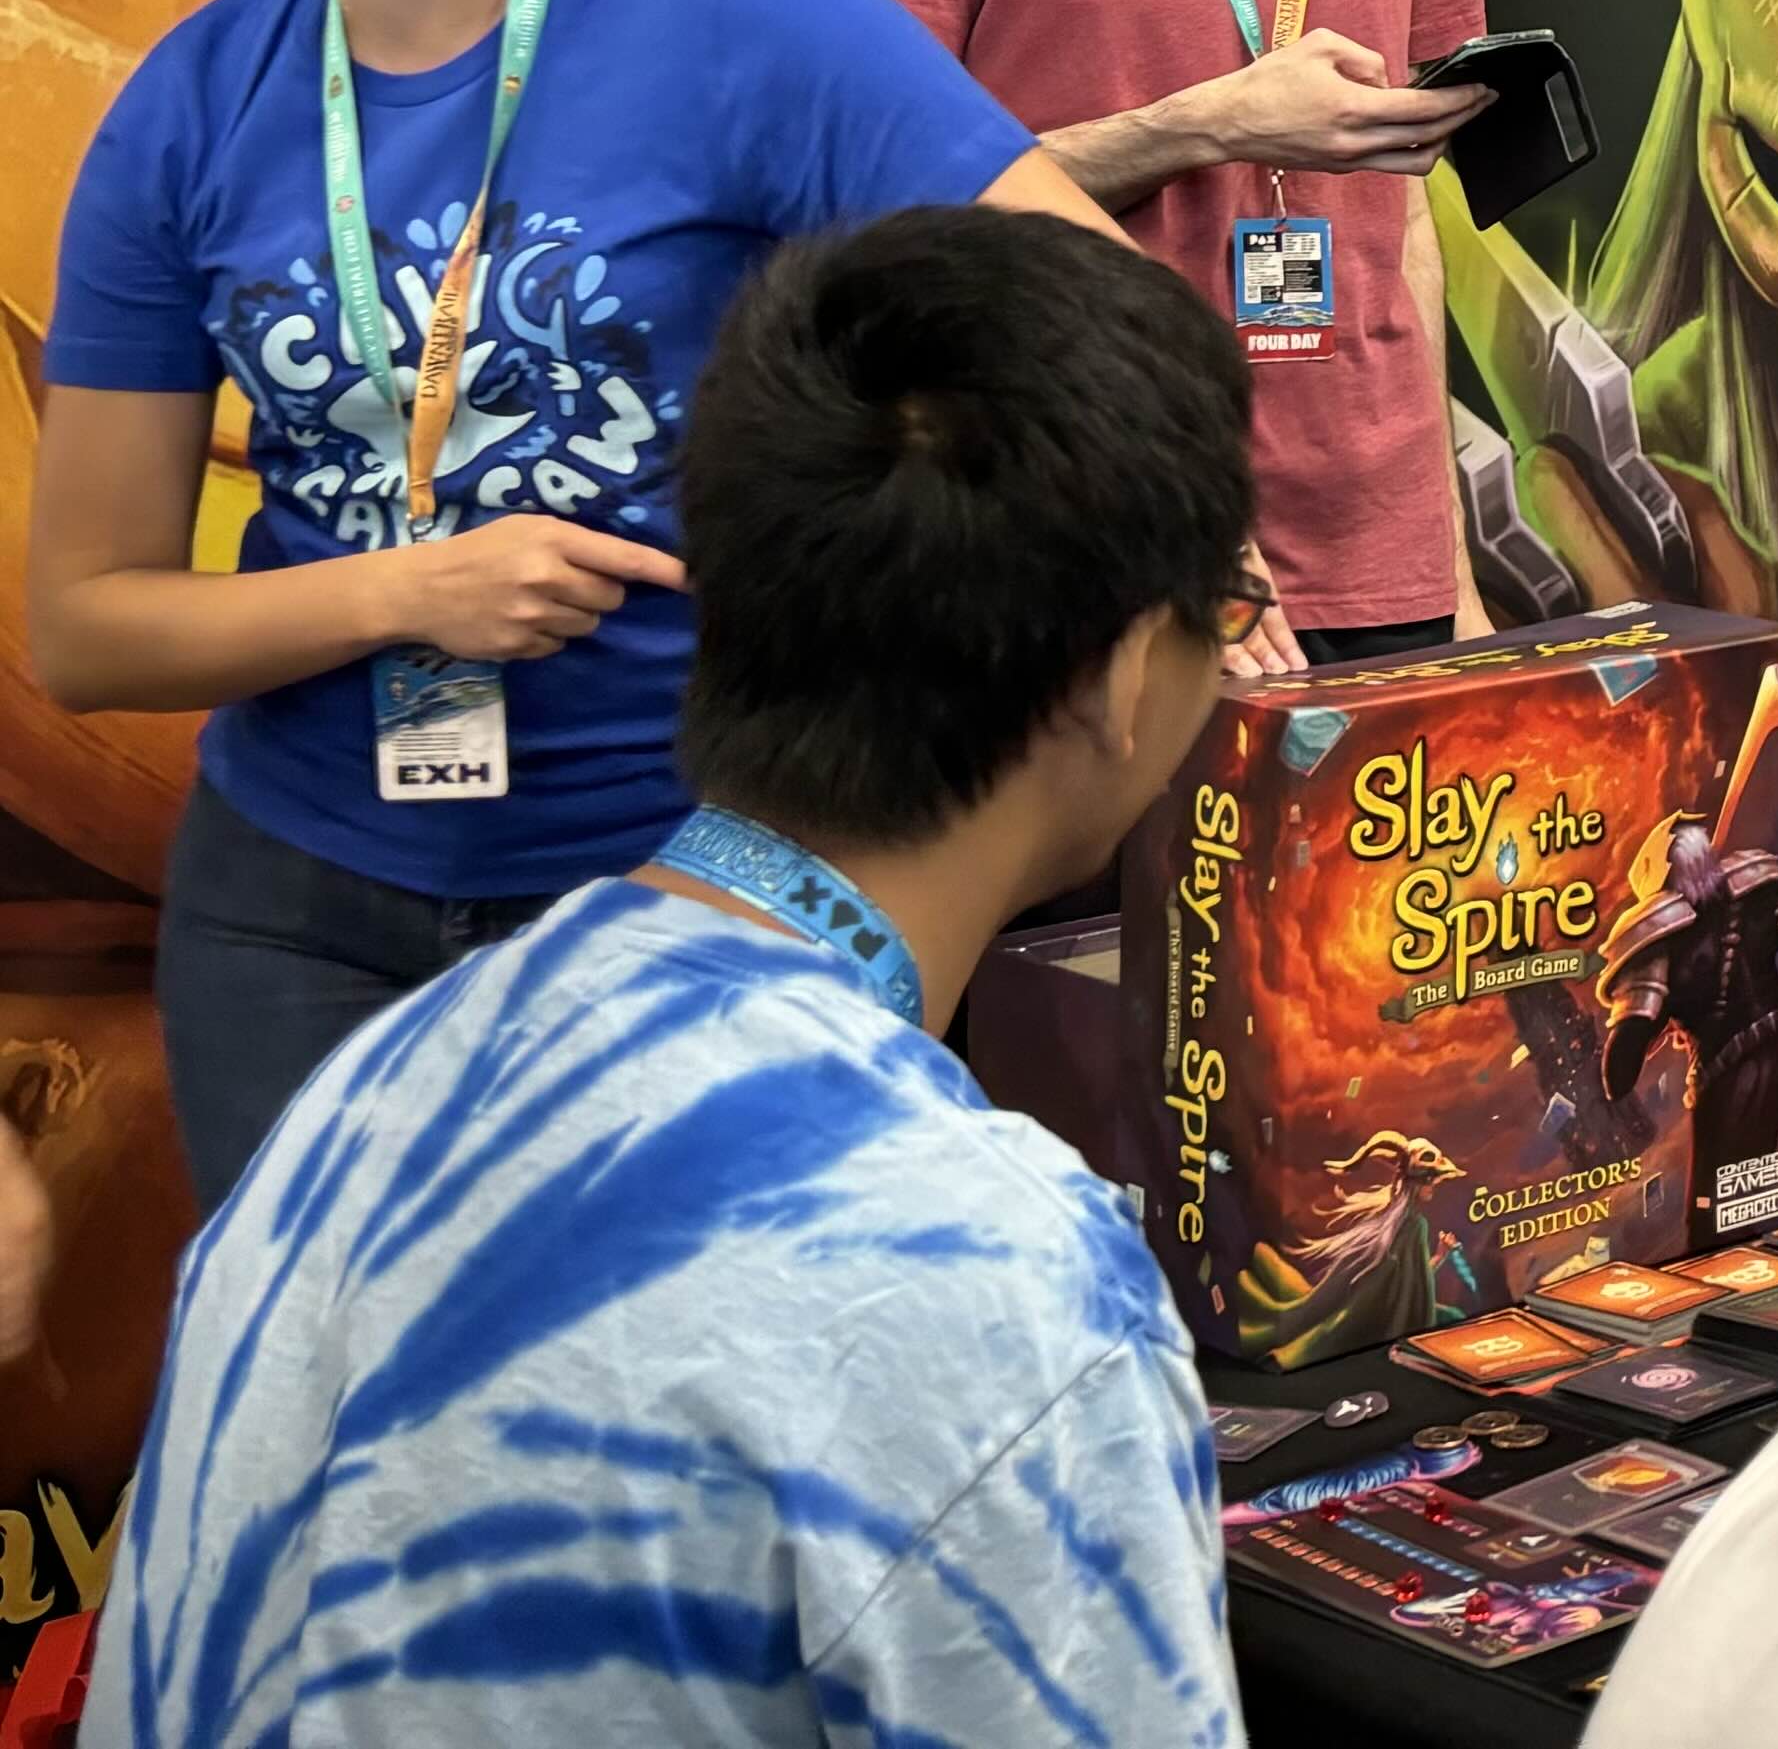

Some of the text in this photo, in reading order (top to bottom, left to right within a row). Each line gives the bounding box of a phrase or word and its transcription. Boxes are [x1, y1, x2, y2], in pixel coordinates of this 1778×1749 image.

[1247, 332, 1322, 352] FOUR DAY
[397, 762, 491, 785] EXH
[1350, 738, 1605, 872] Slay the
[1391, 869, 1597, 1002] Spire
[1412, 953, 1580, 1009] The Board Game
[1164, 783, 1245, 1245] Slay the Spire
[1467, 1157, 1643, 1224] COLLECTOR'S
[1499, 1196, 1614, 1251] EDITION
